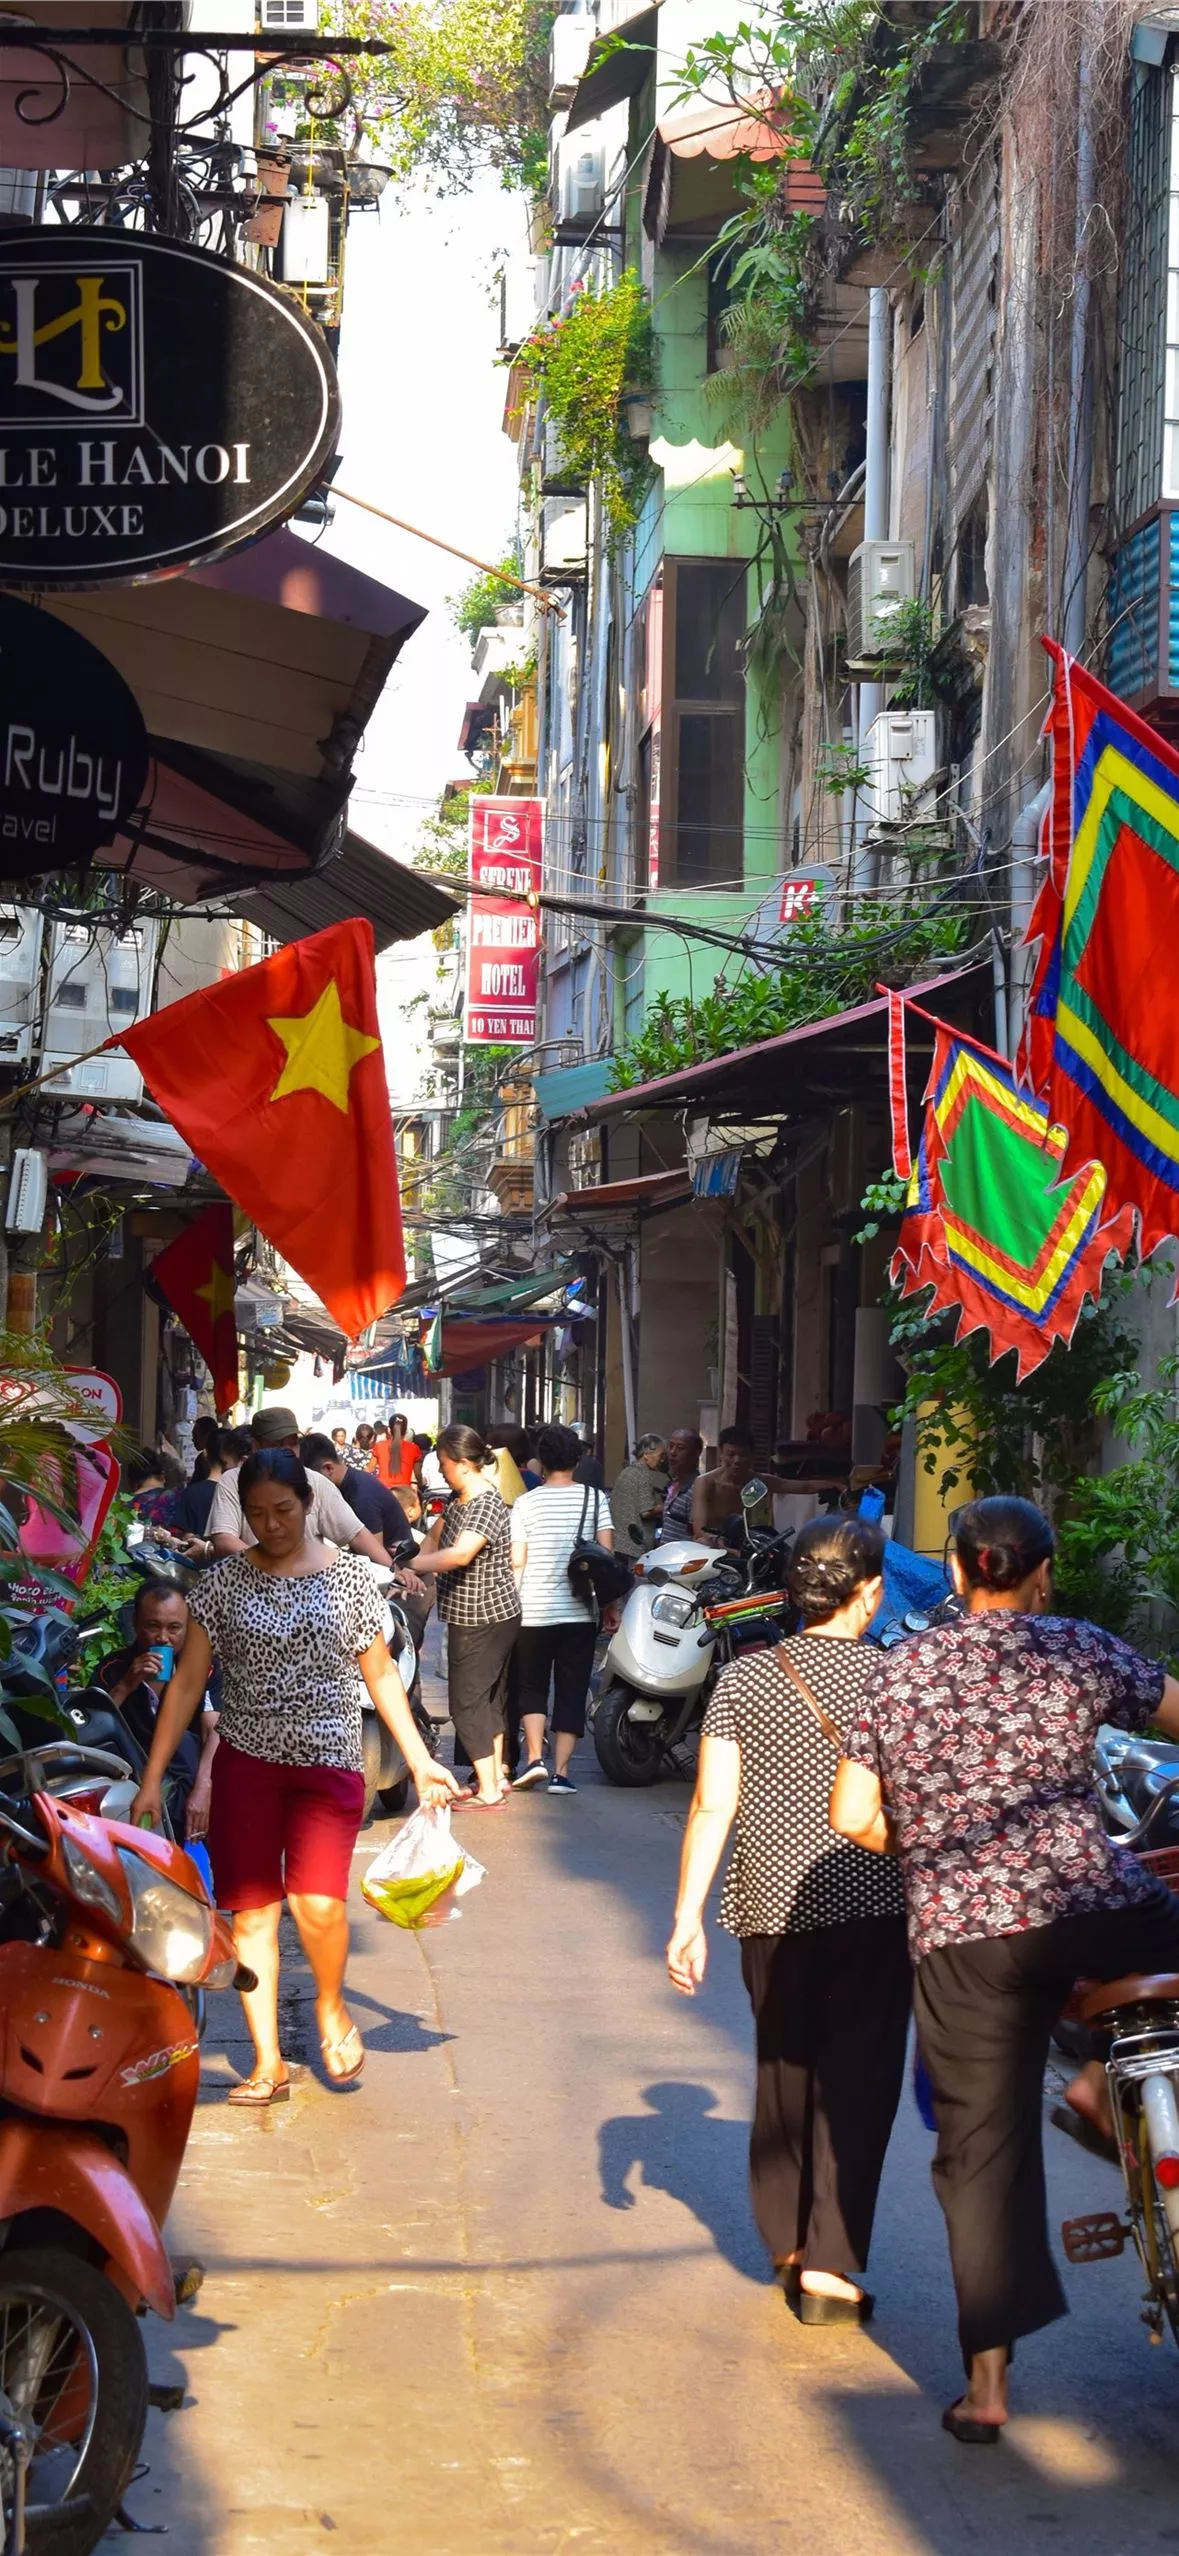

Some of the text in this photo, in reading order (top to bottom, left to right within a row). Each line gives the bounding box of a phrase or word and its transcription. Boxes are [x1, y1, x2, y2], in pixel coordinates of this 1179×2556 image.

[77, 441, 251, 487] HANOI
[0, 504, 145, 538] ELUXE
[4, 723, 123, 821] Ruby
[0, 814, 57, 843] avel
[472, 914, 537, 948] PREMIER
[480, 962, 526, 997] HOTEL
[471, 1017, 535, 1036] 10 YEN THAI
[51, 1976, 111, 2000] HONDA
